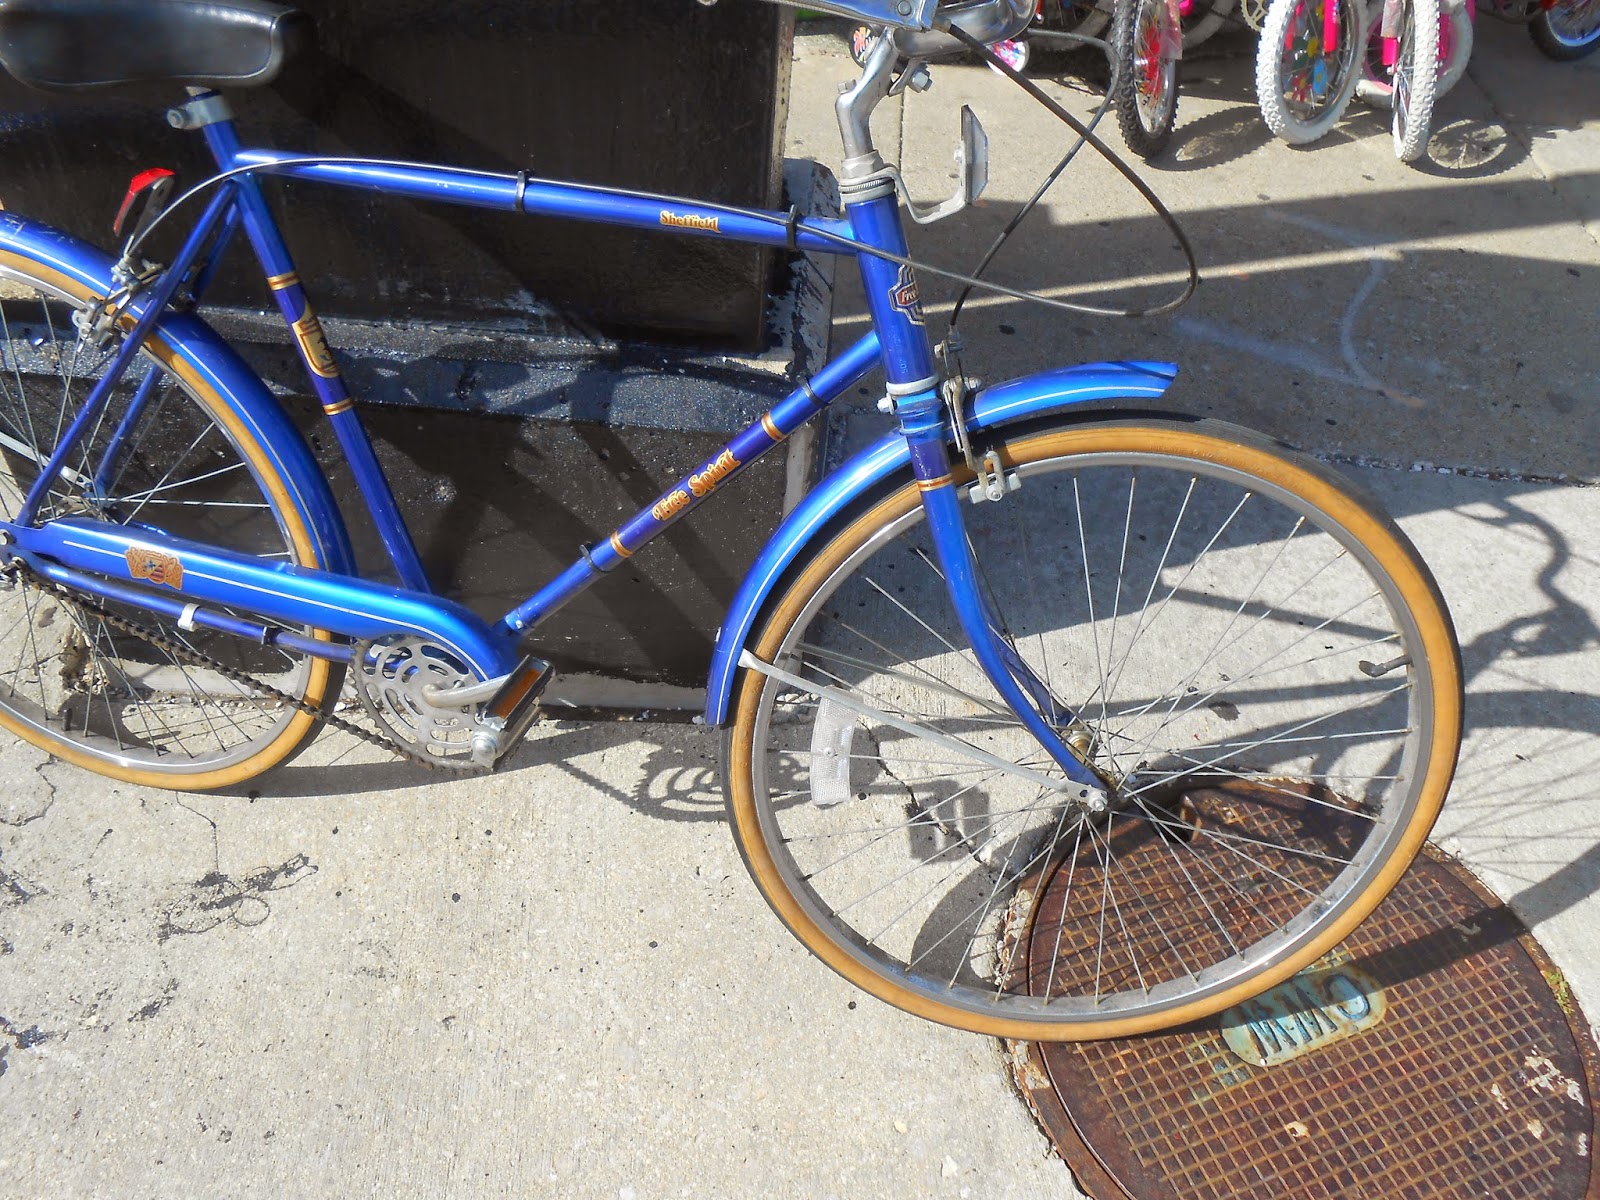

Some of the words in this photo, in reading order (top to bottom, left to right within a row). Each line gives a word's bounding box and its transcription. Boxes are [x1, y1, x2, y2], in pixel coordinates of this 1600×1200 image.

[660, 210, 720, 233] Sheffield
[652, 490, 691, 521] Free
[688, 448, 741, 497] Spirit
